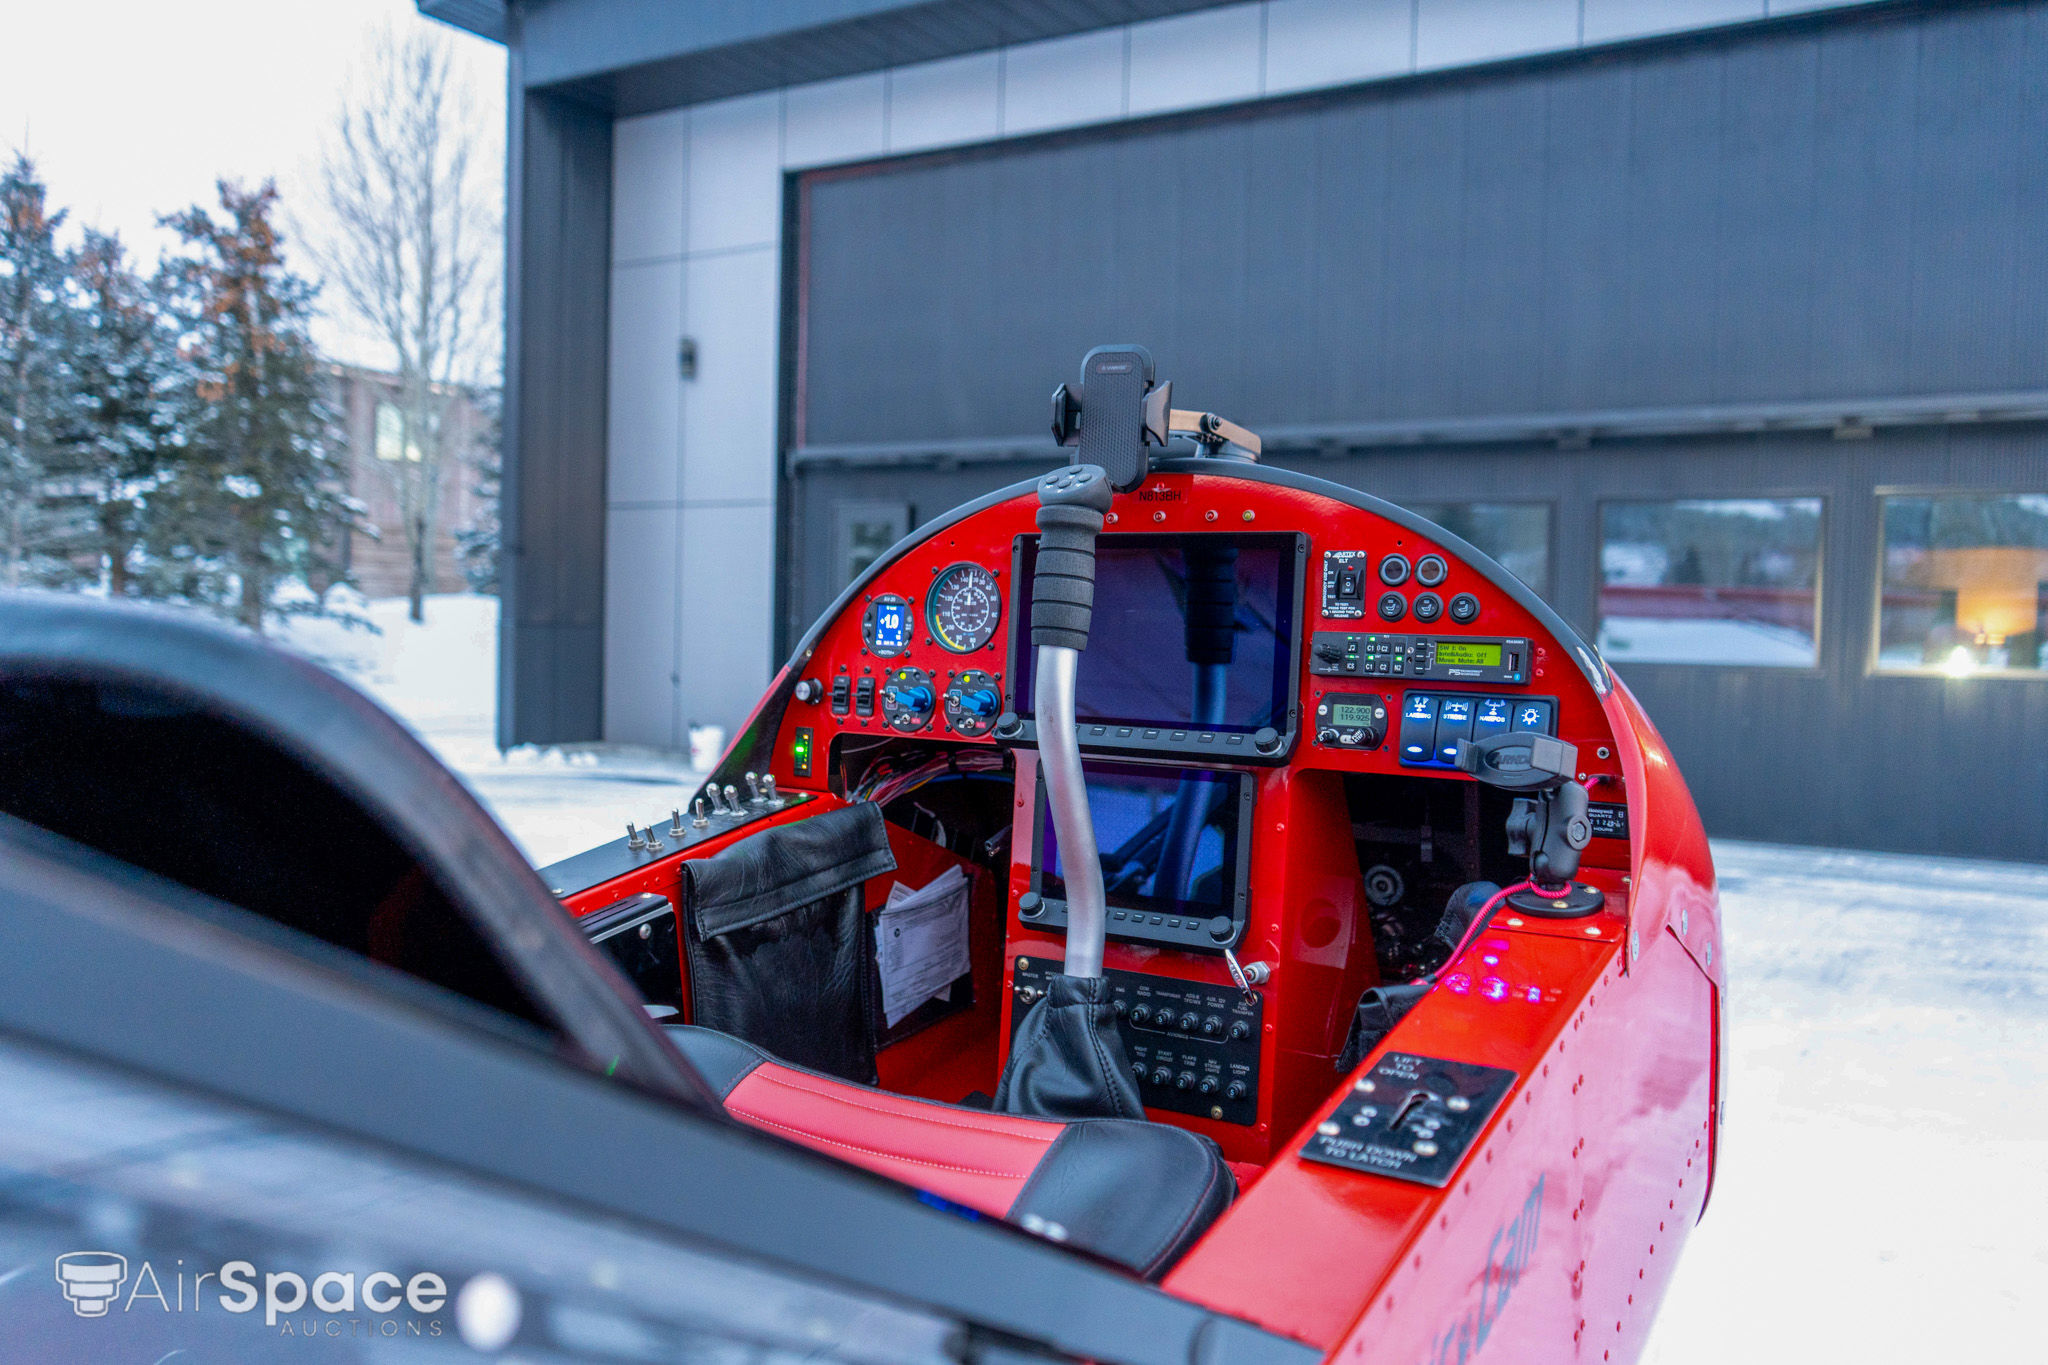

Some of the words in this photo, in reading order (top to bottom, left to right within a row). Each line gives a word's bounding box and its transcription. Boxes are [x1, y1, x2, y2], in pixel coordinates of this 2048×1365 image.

[1139, 490, 1181, 501] N813BH
[1340, 706, 1370, 714] 122.900
[1340, 714, 1370, 722] 119.925
[1393, 1055, 1423, 1065] LIFT
[1229, 1063, 1250, 1071] LANDING
[1396, 1063, 1414, 1071] TO
[1378, 1067, 1419, 1080] OPEN
[1319, 1135, 1364, 1151] PUSH
[1365, 1143, 1417, 1162] DOWN
[1325, 1146, 1347, 1158] TO
[1349, 1150, 1402, 1169] LATCH
